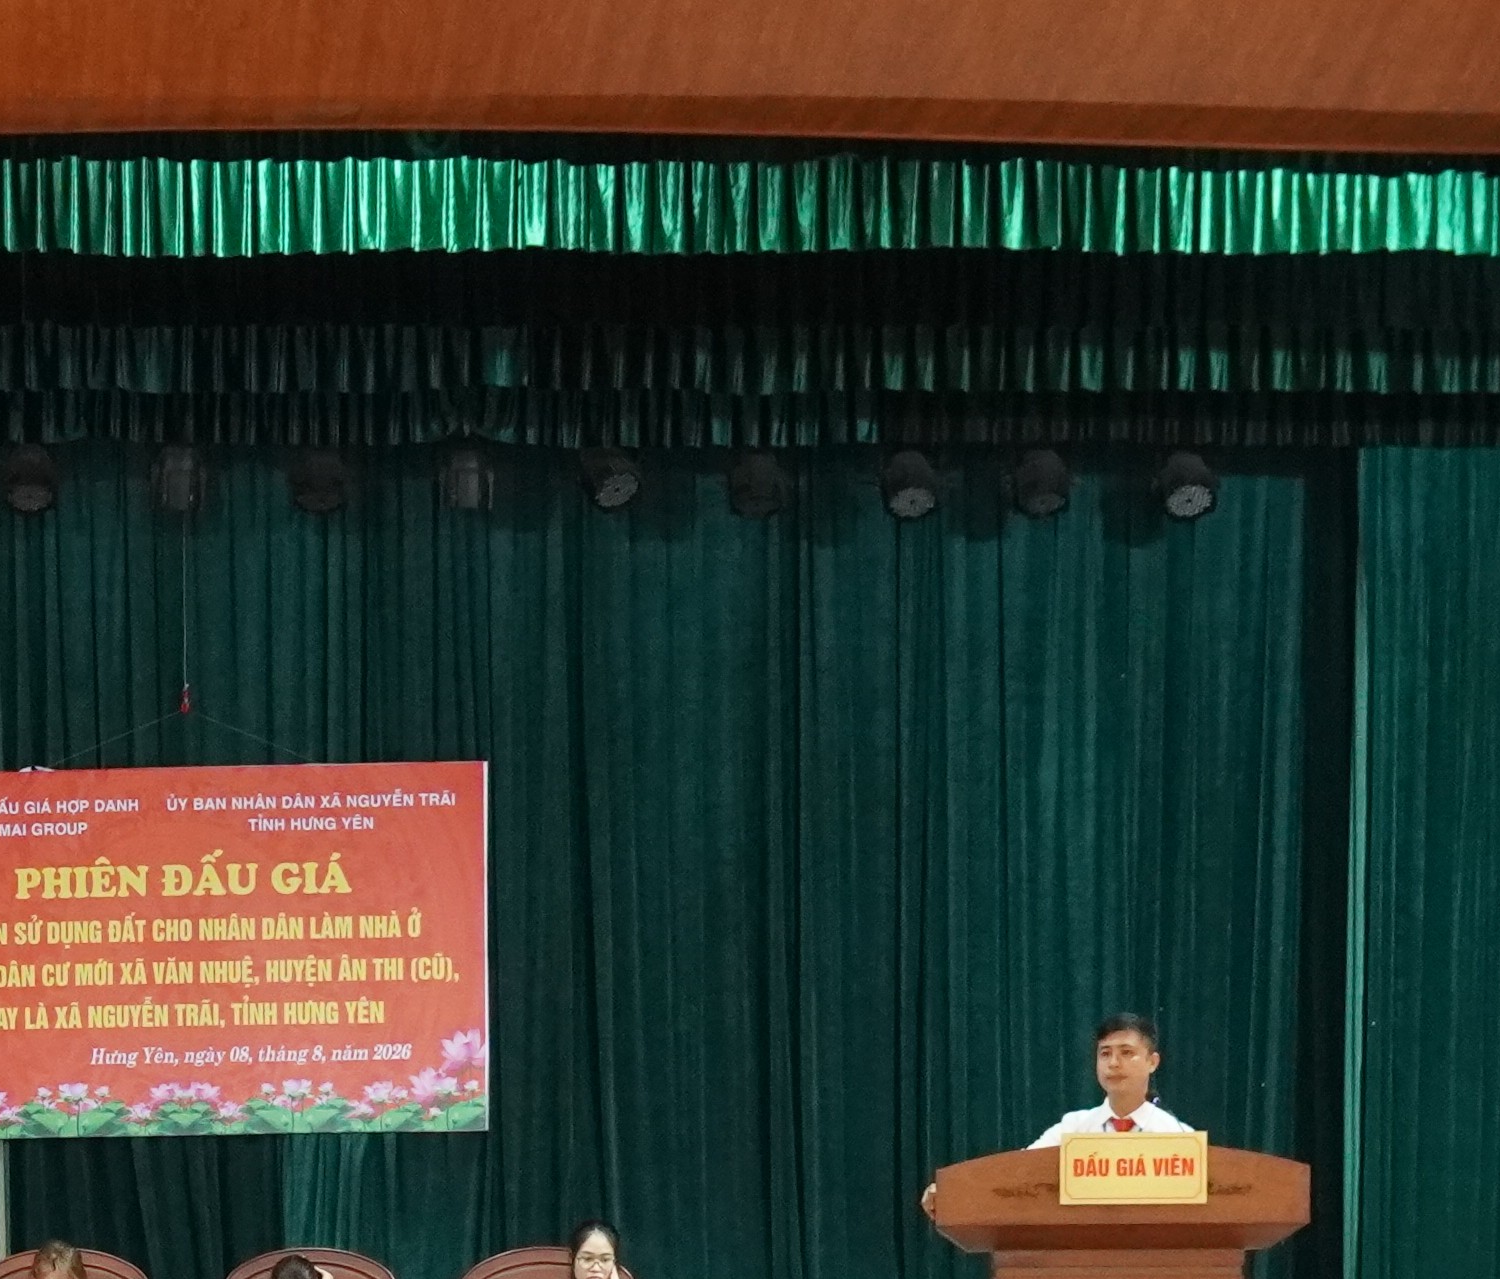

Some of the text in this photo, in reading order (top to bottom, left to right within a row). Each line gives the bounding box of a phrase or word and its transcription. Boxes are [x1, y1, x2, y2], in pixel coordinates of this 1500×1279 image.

[23, 796, 52, 815] GIÁ
[55, 797, 92, 818] HỢP
[95, 798, 139, 813] DANH
[166, 788, 455, 812] ỦY BAN NHÂN DÂN XÃ NGUYỄN TRÃI
[32, 821, 88, 837] GROUP
[248, 814, 374, 832] TỈNH HƯNG YÊN
[14, 849, 352, 900] PHIÊN ĐẤU GIÁ
[13, 915, 42, 947] SỬ
[46, 919, 102, 952] DỤNG
[107, 912, 146, 943] ĐẤT
[151, 916, 193, 943] CHO
[198, 911, 256, 942] NHÂN
[261, 911, 304, 941] DÂN
[309, 910, 355, 941] LÀM
[358, 908, 402, 940] NHÀ
[407, 907, 421, 939] Ở
[42, 961, 71, 988] CƯ
[75, 958, 115, 988] MỚI
[119, 960, 147, 987] XÃ
[199, 957, 260, 990] NHUỆ,
[265, 956, 333, 988] HUYỆN
[338, 952, 368, 983] ÂN
[373, 957, 404, 982] THI
[410, 952, 459, 984] (CŨ),
[23, 1001, 50, 1030] LÀ
[54, 1000, 82, 1029] XÃ
[88, 995, 169, 1029] NGUYỄN
[175, 998, 226, 1031] TRÃI,
[233, 994, 279, 1026] TỈNH
[284, 997, 340, 1025] HƯNG
[344, 995, 385, 1024] YÊN
[89, 1047, 136, 1067] Hưng
[140, 1046, 180, 1067] Yên,
[183, 1048, 225, 1068] ngày
[229, 1046, 253, 1065] 08,
[256, 1045, 308, 1065] tháng
[331, 1047, 368, 1063] năm
[372, 1044, 412, 1062] 2026
[1073, 1152, 1194, 1176] ĐẤU GIÁ VIÊN
